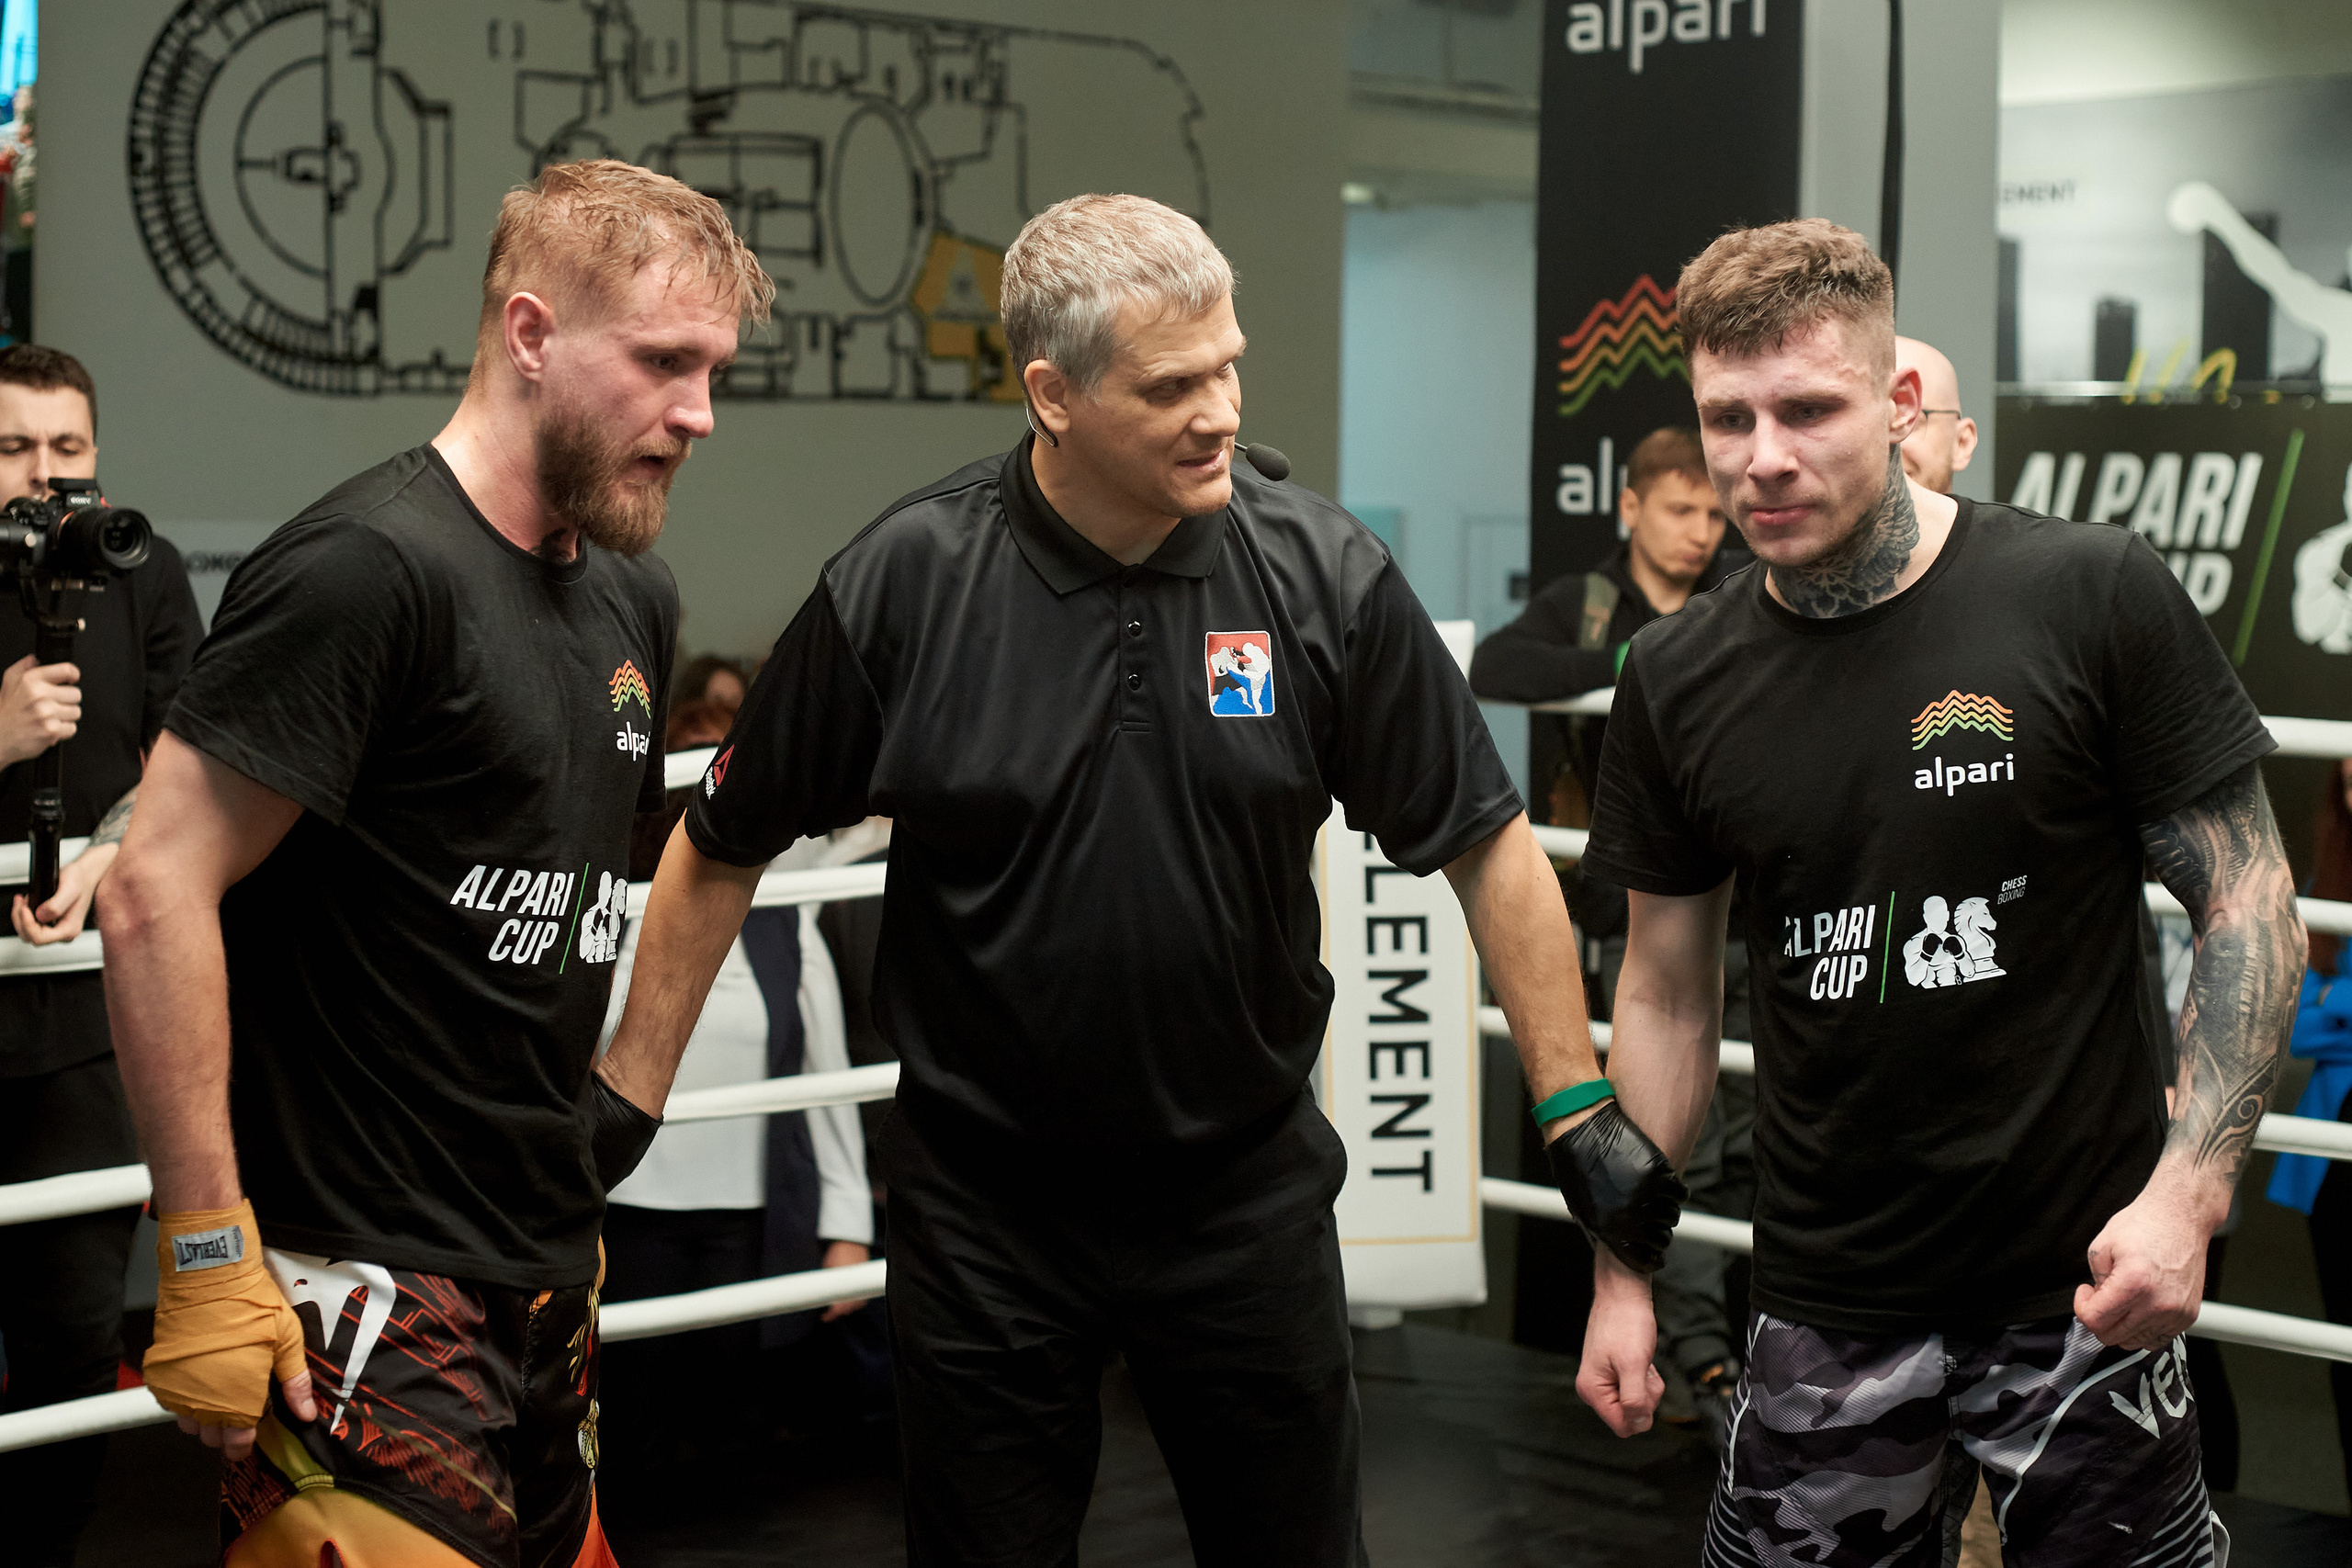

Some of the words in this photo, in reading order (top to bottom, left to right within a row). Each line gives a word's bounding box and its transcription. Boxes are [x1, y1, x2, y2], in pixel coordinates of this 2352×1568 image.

[1915, 753, 2014, 796] alpari
[450, 865, 575, 916] ALPARI
[1997, 886, 2026, 905] BOXING
[2002, 874, 2027, 892] CHESS
[488, 919, 560, 964] CUP
[1810, 955, 1868, 1000] CUP
[175, 1235, 228, 1266] EVERLAST
